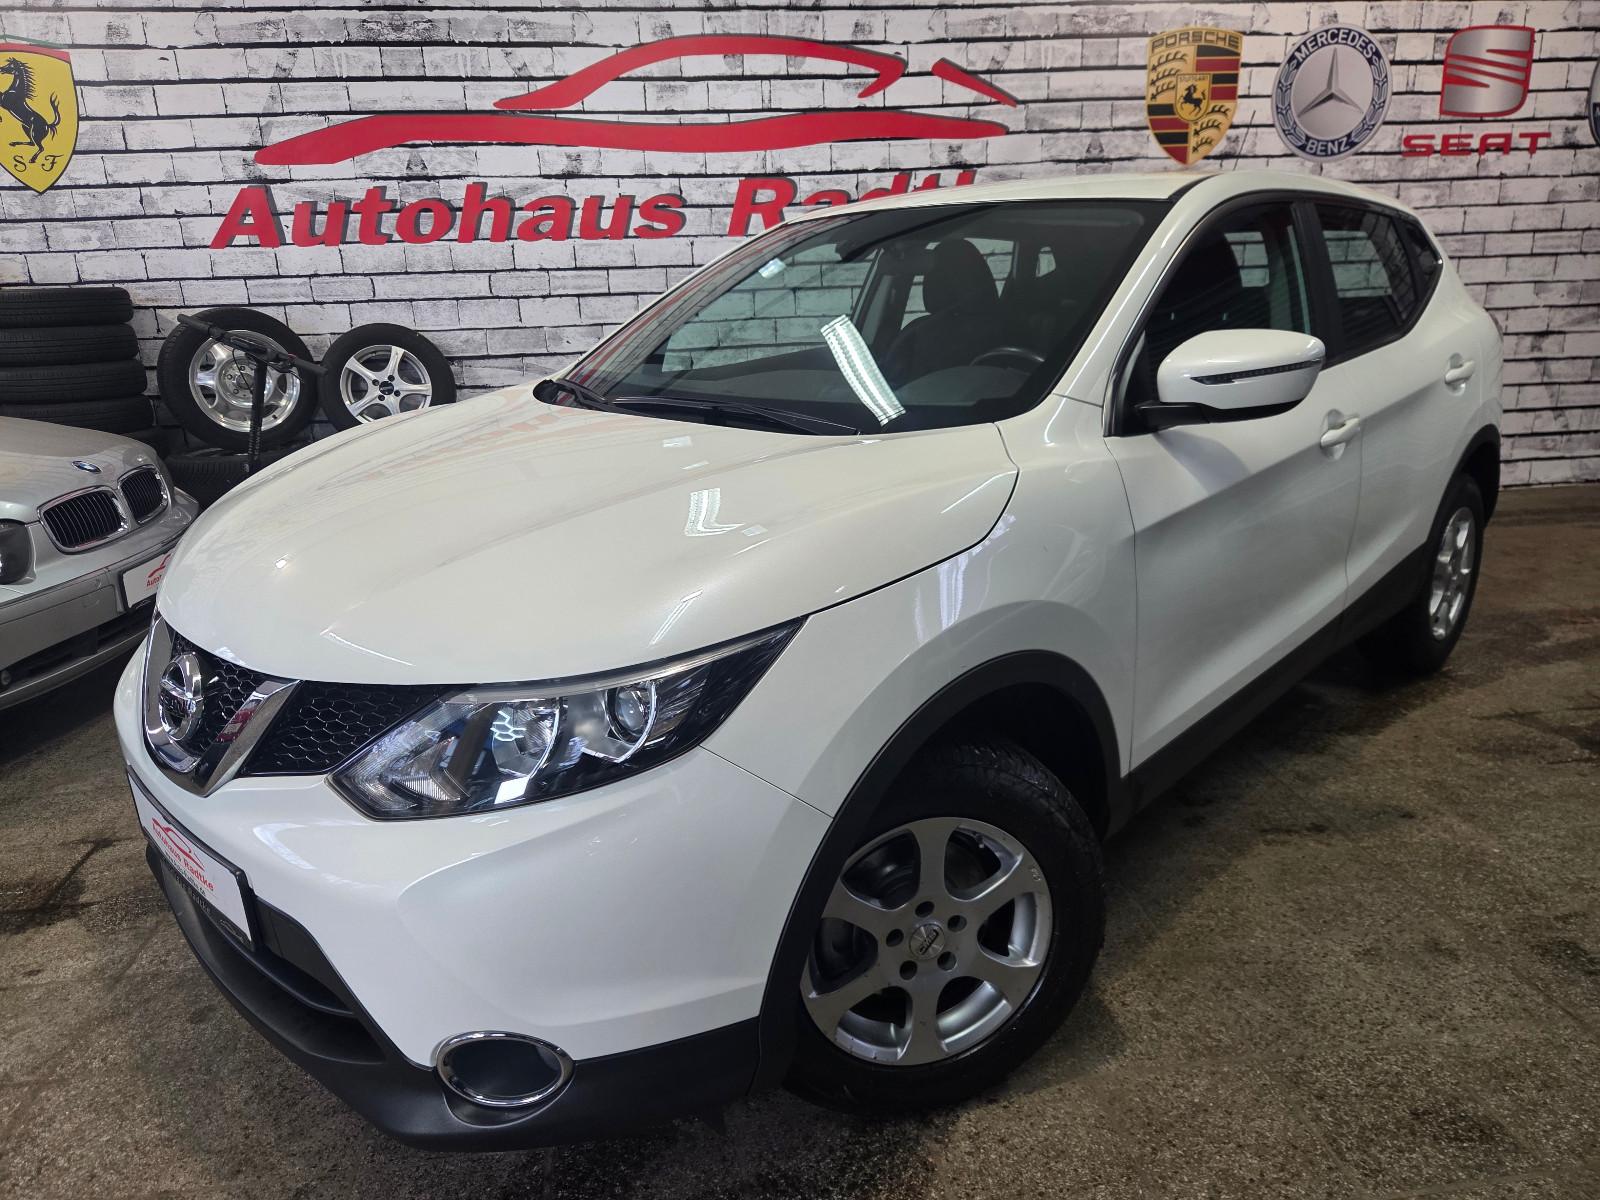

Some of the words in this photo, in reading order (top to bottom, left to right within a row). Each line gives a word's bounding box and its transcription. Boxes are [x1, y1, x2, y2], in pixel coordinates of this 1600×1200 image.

[1152, 31, 1239, 54] PORSCHE
[1294, 29, 1376, 62] MERCEDES
[1305, 137, 1350, 155] BENZ
[1401, 132, 1552, 157] SEAT
[13, 155, 27, 172] S
[41, 154, 64, 172] F
[210, 181, 687, 249] Autohaus
